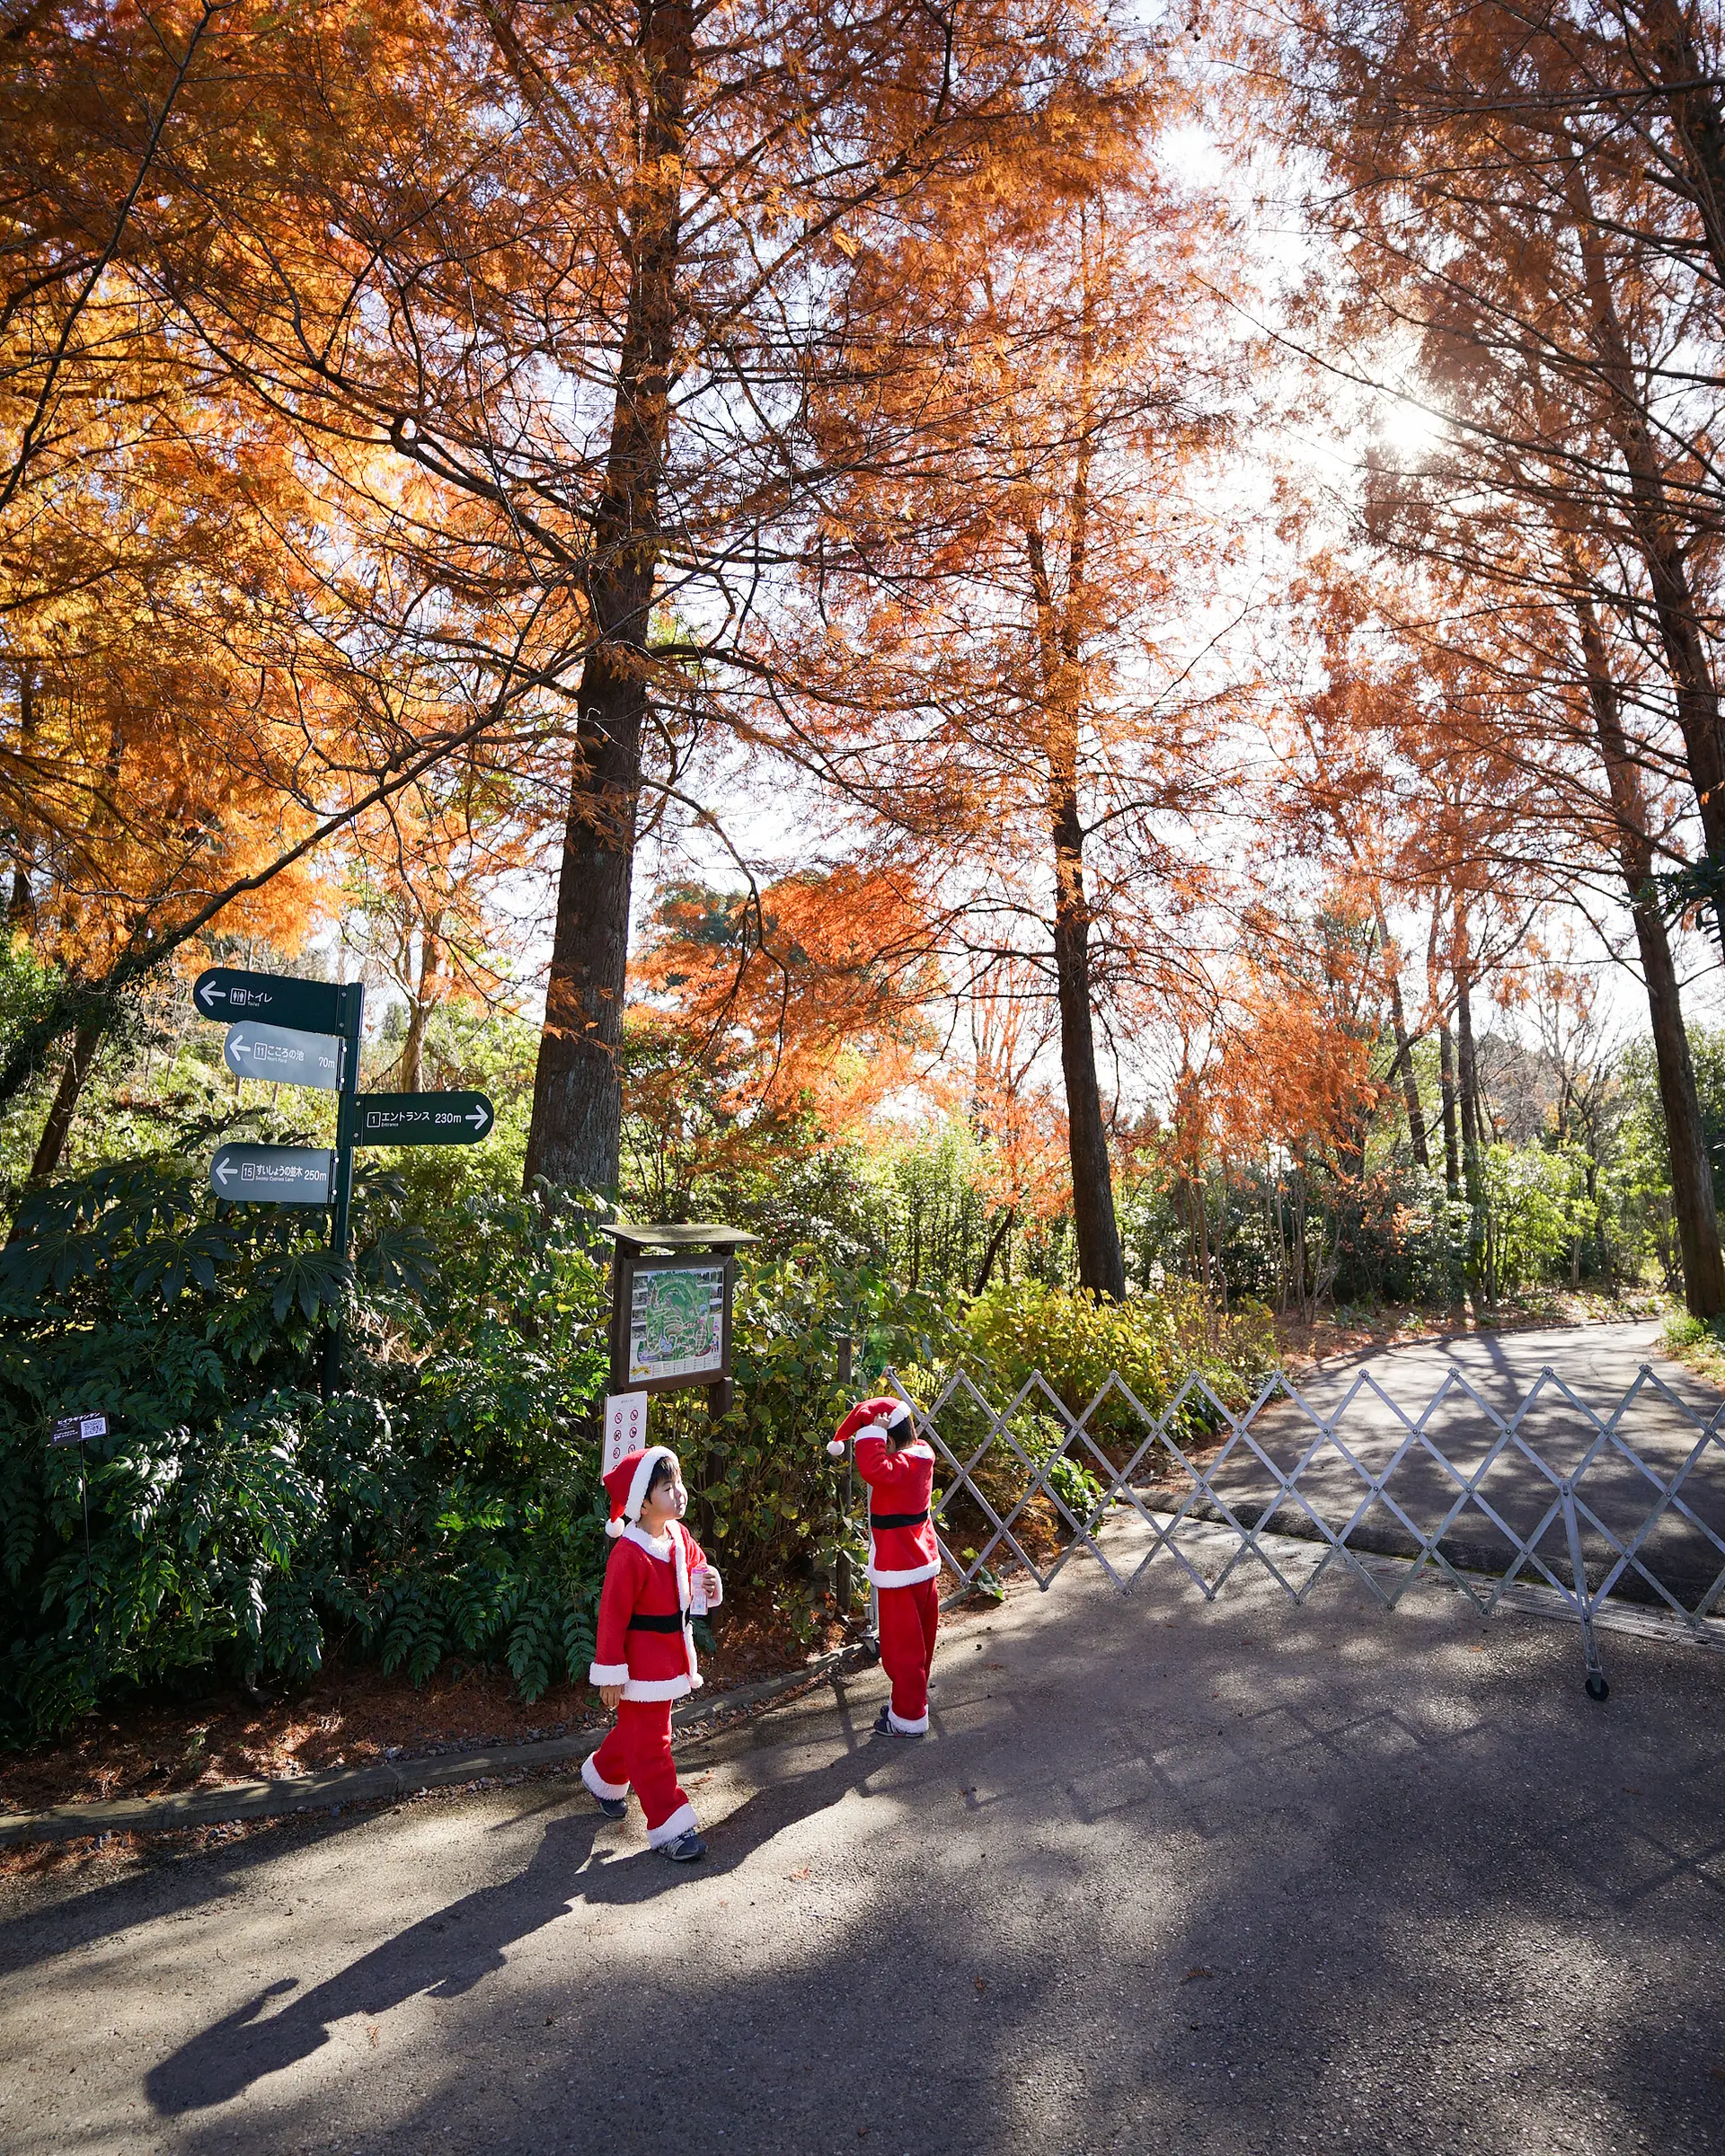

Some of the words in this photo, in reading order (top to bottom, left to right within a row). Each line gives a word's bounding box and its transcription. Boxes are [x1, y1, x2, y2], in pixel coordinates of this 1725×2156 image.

[248, 990, 273, 1003] トイレ
[257, 1047, 264, 1056] 11
[268, 1046, 305, 1061] こころの池
[318, 1056, 335, 1069] 70m
[382, 1111, 429, 1122] エントランス
[435, 1113, 462, 1124] 230m
[243, 1168, 252, 1177] 15
[256, 1164, 303, 1178] すいしょうの並木
[304, 1170, 327, 1181] 250m
[58, 1412, 101, 1425] ヒイラギナンテン
